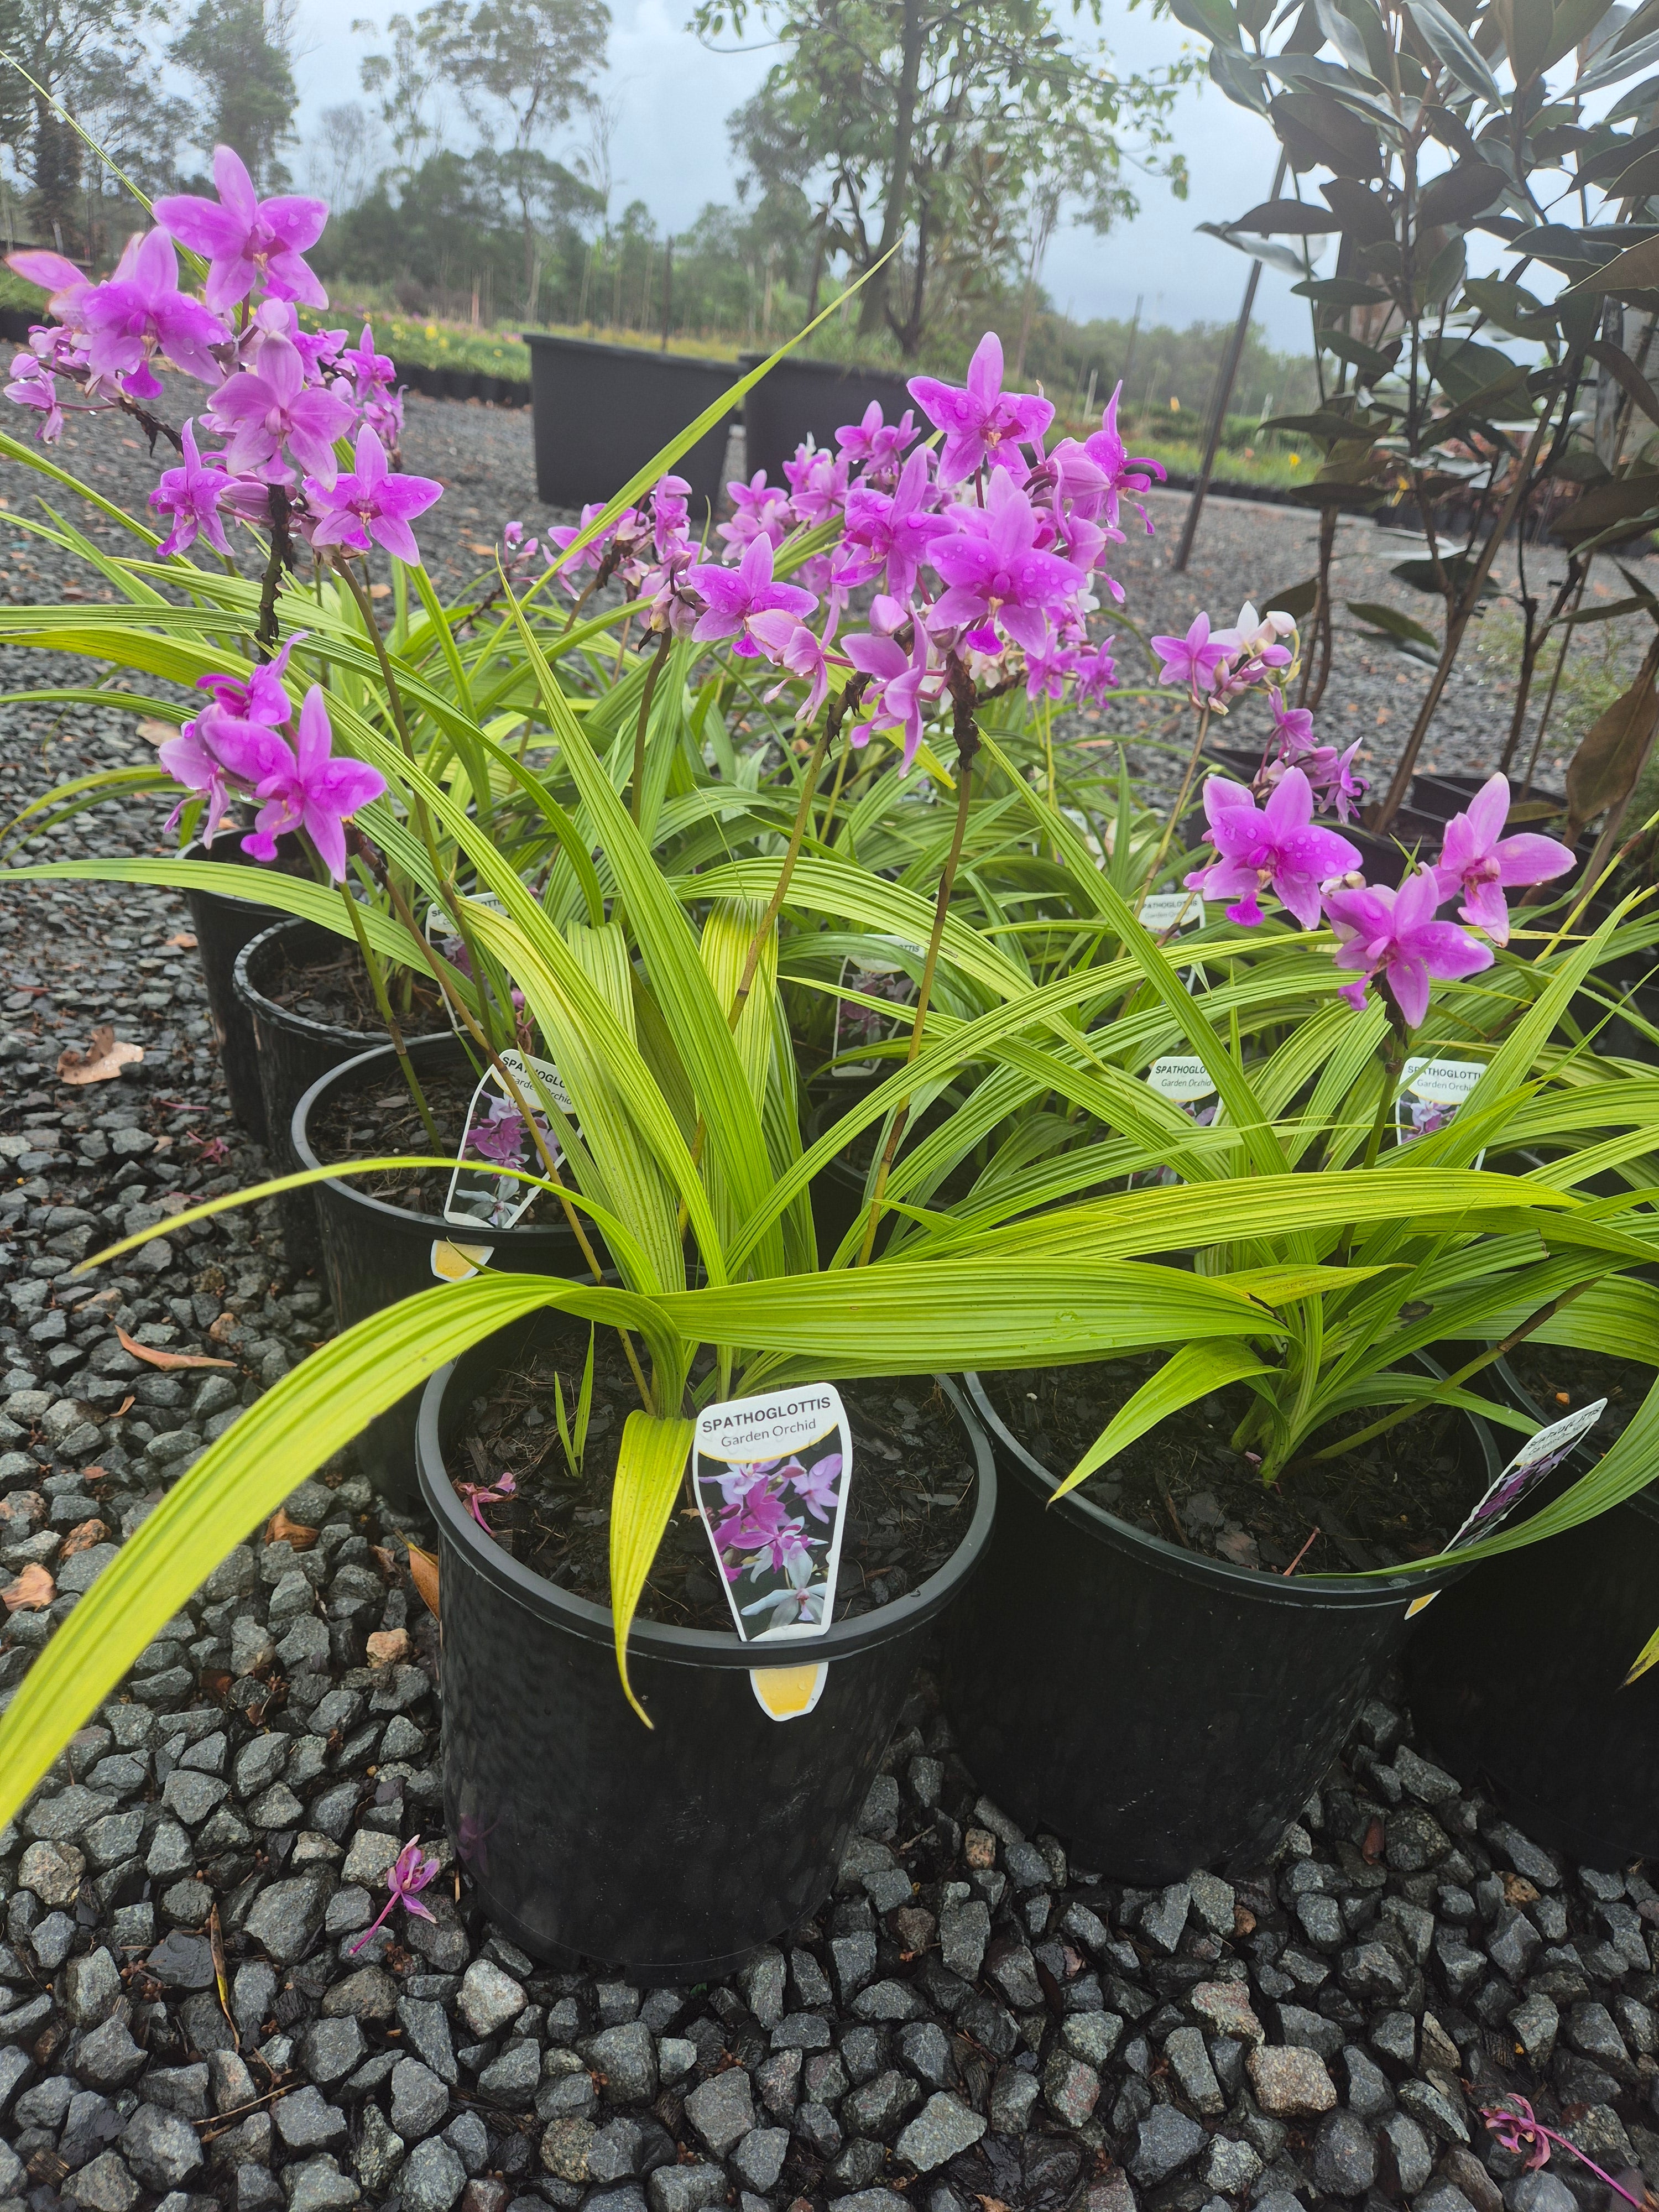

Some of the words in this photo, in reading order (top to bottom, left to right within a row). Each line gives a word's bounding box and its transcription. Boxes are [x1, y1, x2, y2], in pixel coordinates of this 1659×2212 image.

[1155, 1066, 1207, 1074] SPATHOGLO
[1417, 1079, 1447, 1089] Garden
[1449, 1082, 1474, 1091] Orchi
[702, 1397, 831, 1433] SPATHOGLOTTIS
[721, 1429, 769, 1447] Garden
[772, 1418, 816, 1437] Orchid
